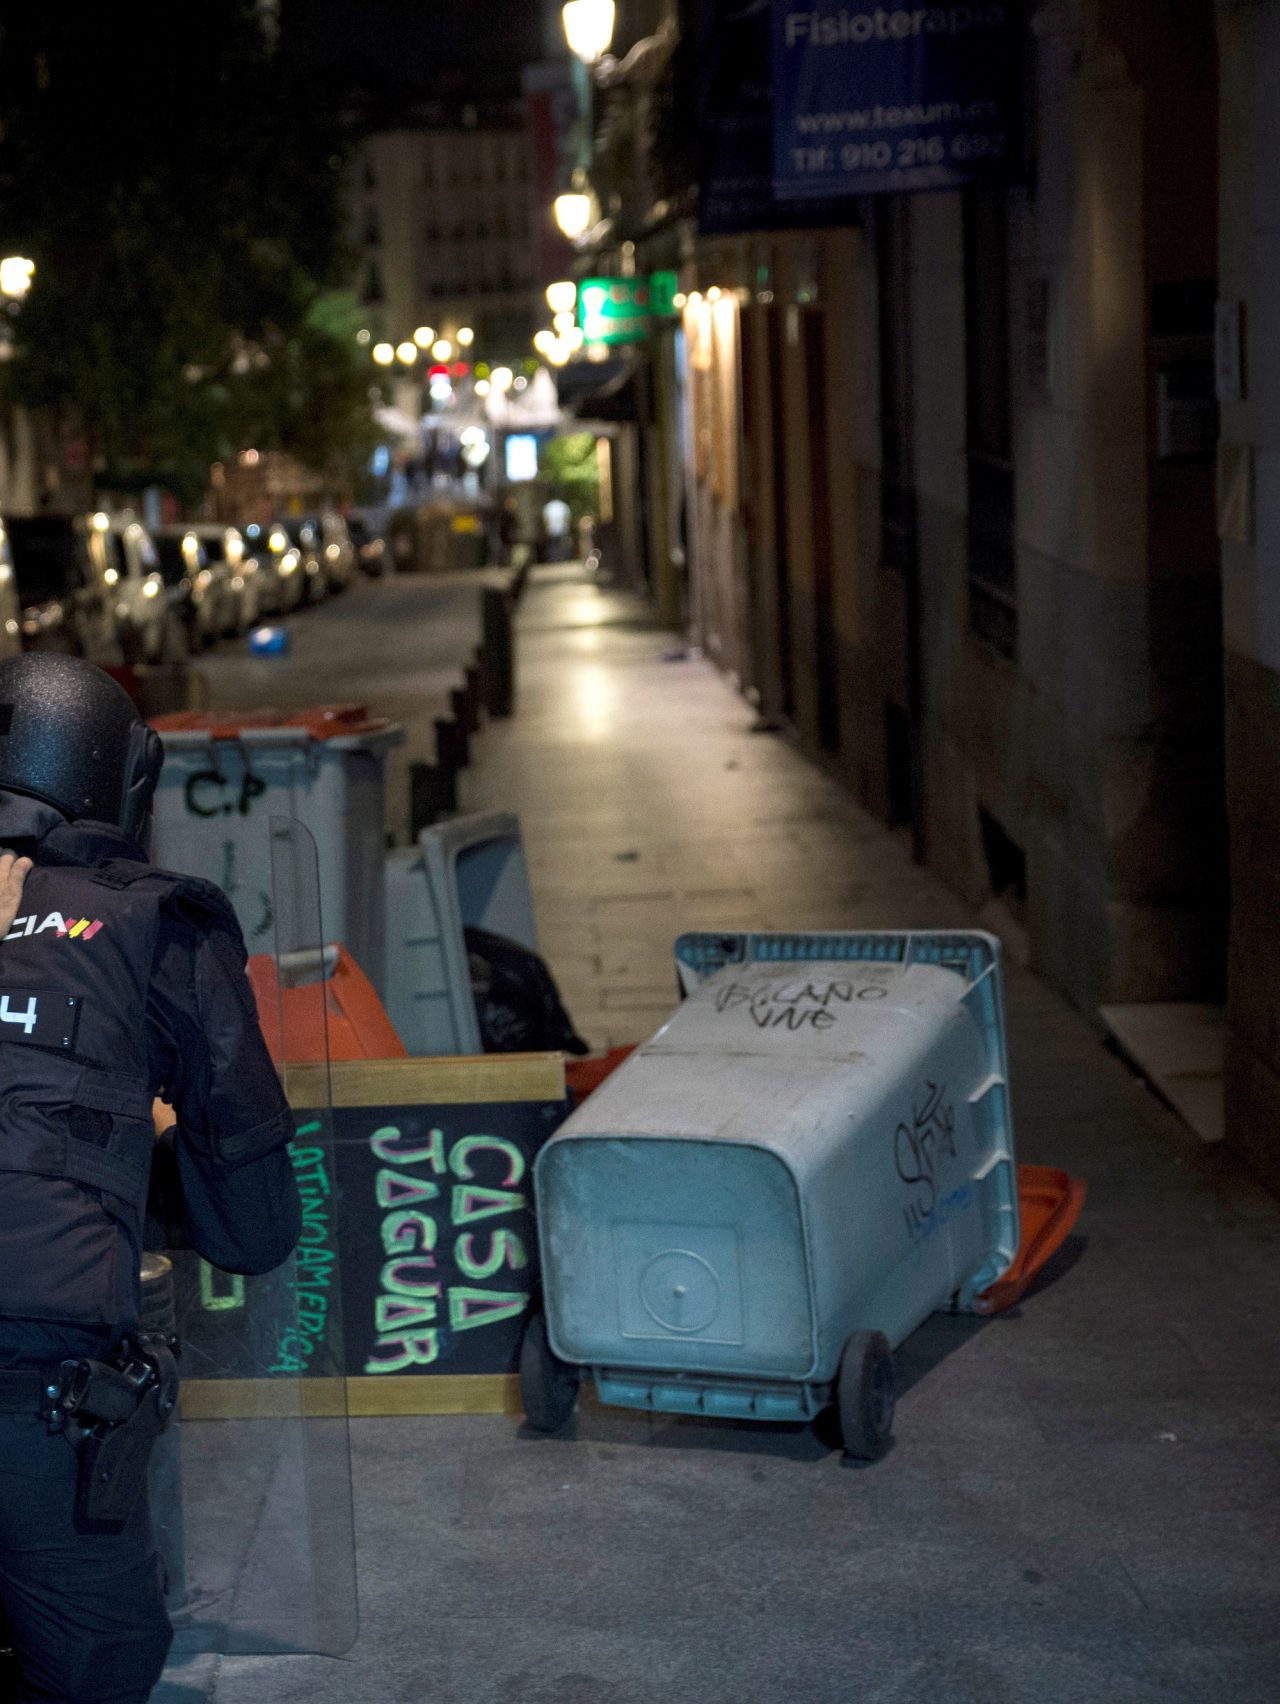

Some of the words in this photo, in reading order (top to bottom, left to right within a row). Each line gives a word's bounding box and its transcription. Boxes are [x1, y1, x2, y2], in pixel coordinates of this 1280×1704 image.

[785, 4, 1005, 47] Fisioterapia
[840, 141, 892, 170] 910
[898, 136, 945, 165] 216
[364, 1126, 445, 1373] JAGUAR
[448, 1134, 532, 1332] CASA
